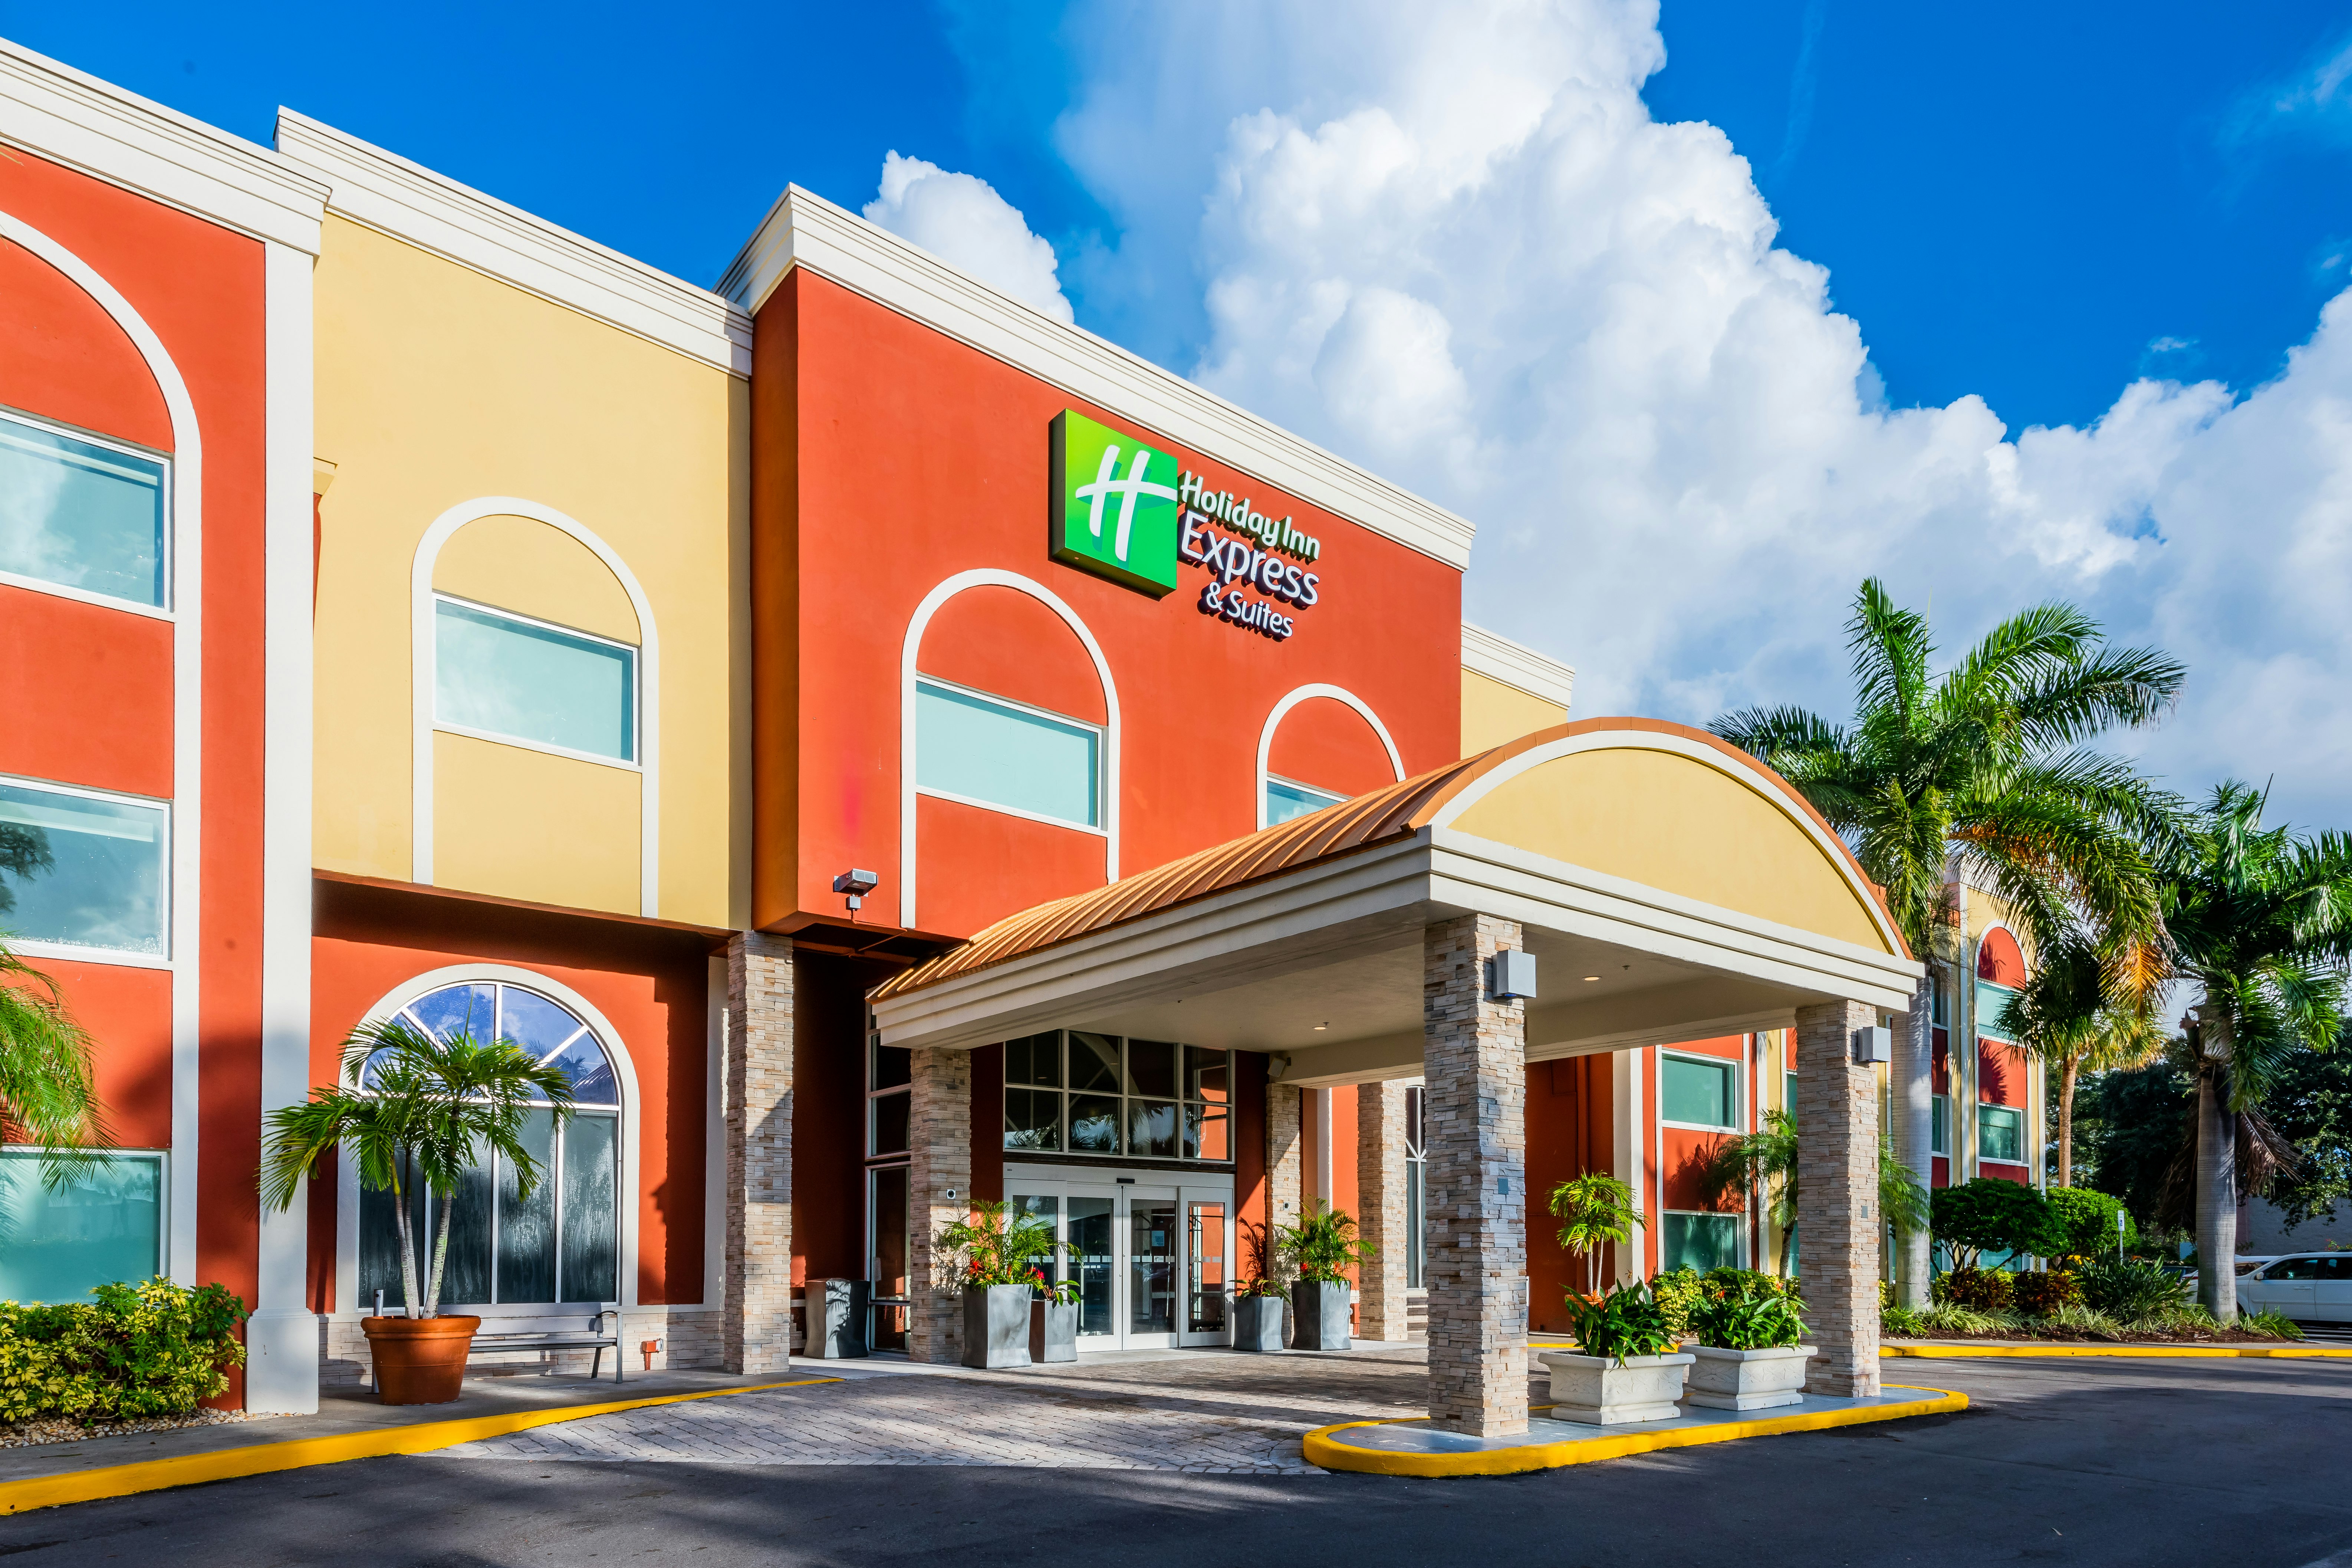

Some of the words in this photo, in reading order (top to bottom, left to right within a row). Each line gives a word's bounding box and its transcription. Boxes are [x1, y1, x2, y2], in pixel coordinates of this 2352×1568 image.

[1075, 444, 1177, 562] H
[1180, 470, 1280, 547] Holiday
[1282, 516, 1320, 560] Inn
[1181, 510, 1320, 605] Express
[1206, 581, 1223, 611] &
[1227, 590, 1294, 637] Suites
